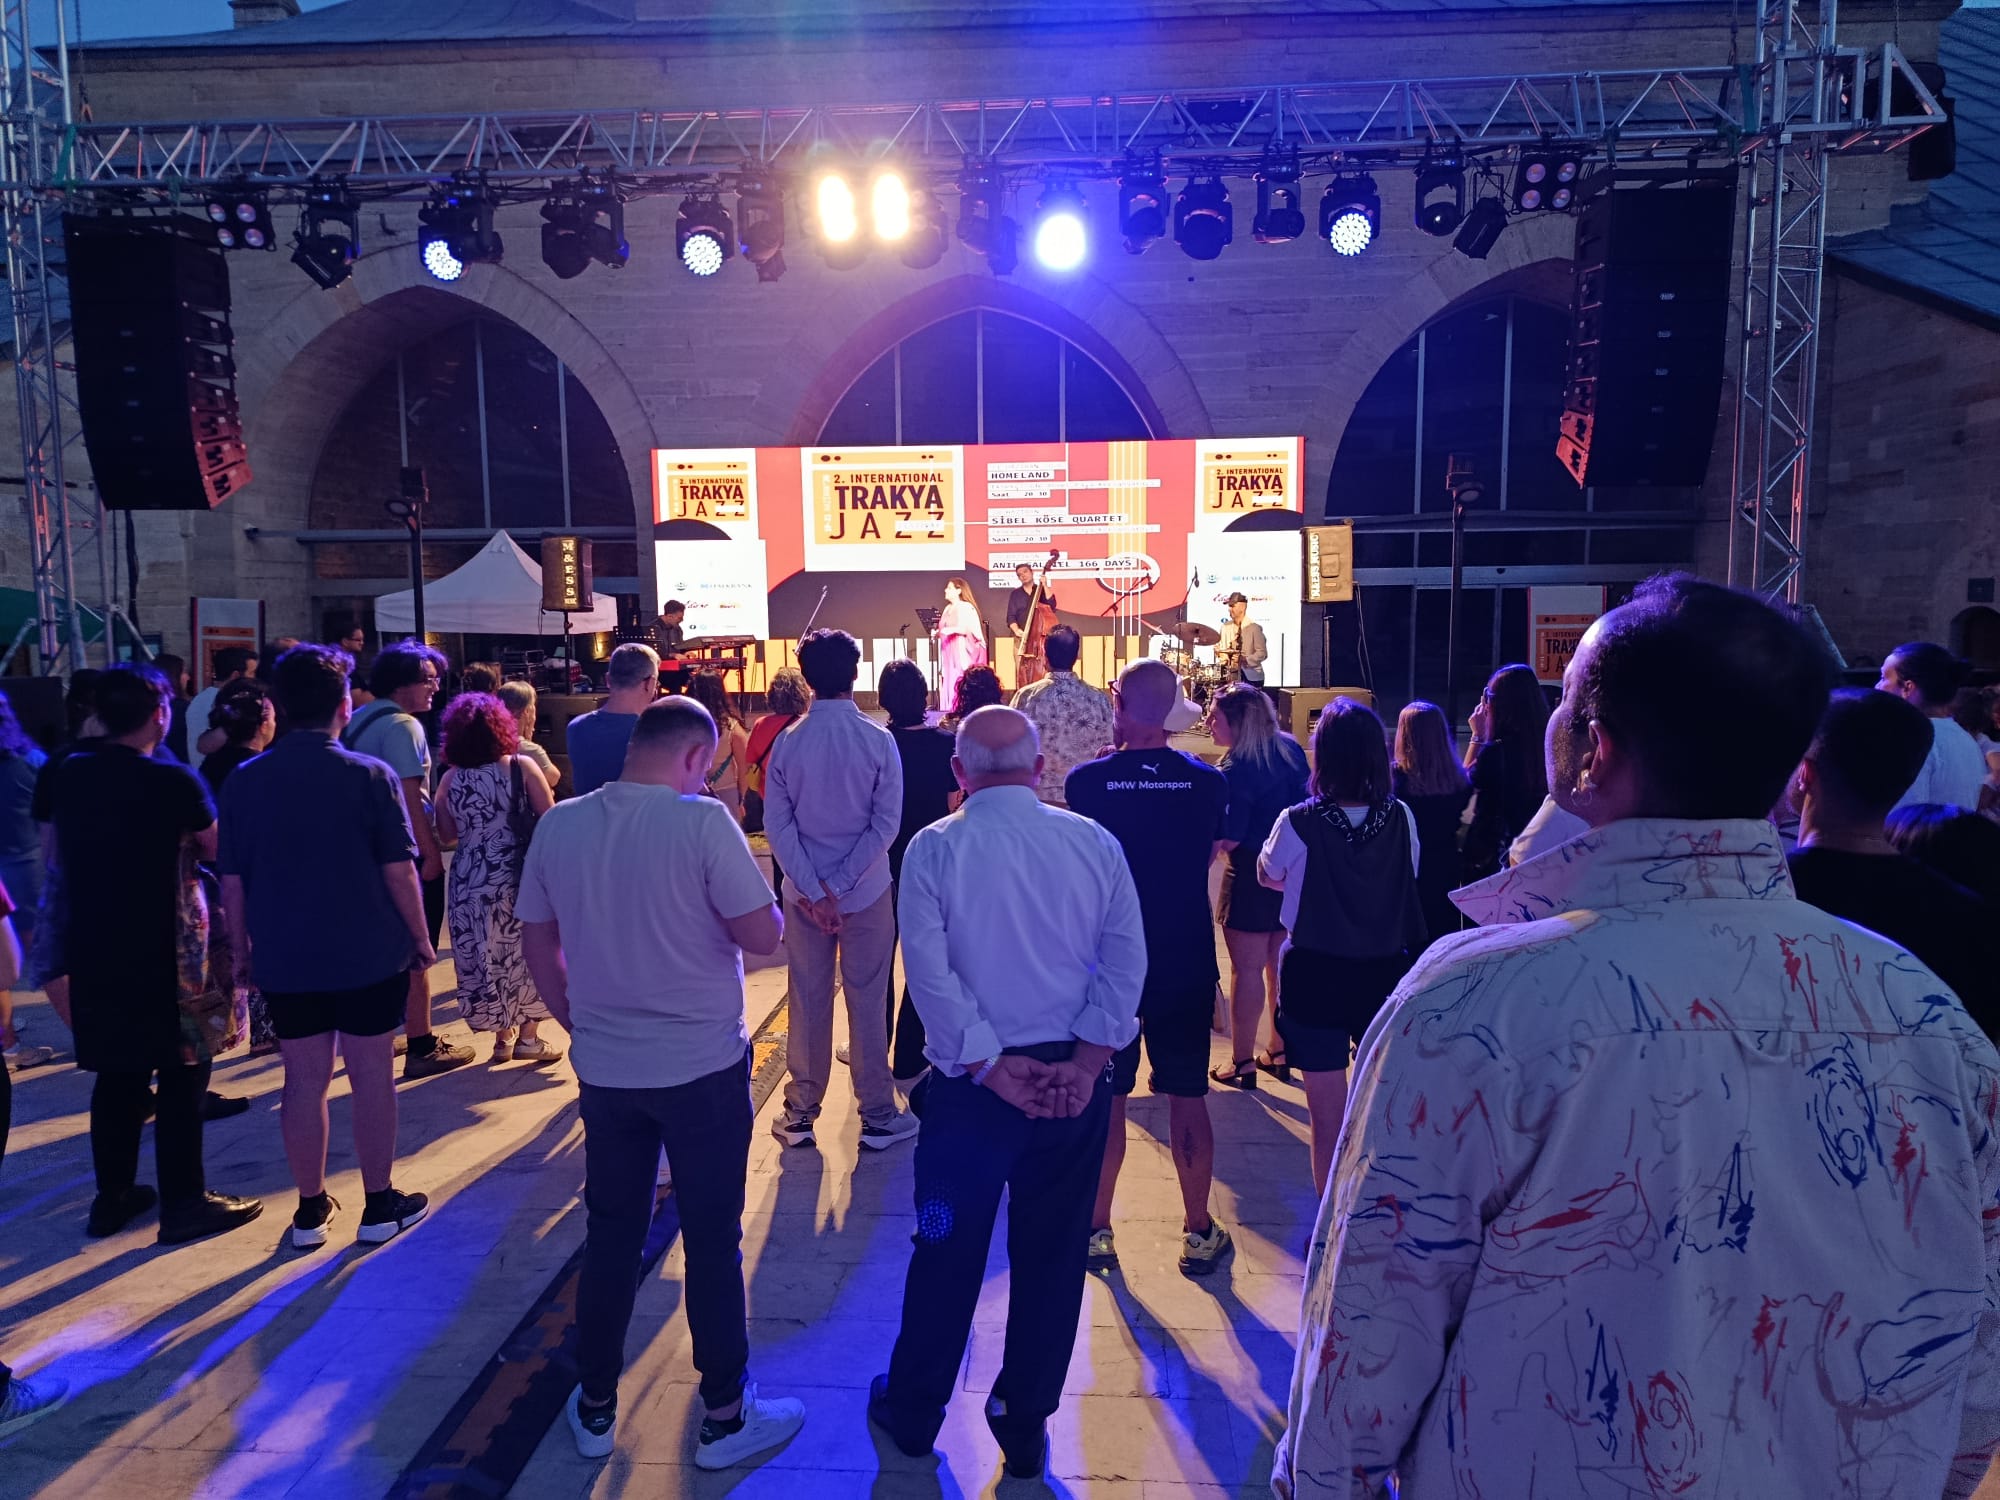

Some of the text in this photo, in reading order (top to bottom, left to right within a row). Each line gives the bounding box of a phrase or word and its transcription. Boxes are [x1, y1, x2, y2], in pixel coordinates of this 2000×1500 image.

[991, 471, 1050, 479] HOMELAND
[1227, 467, 1284, 475] INTERNATIONAL
[834, 473, 944, 484] 2. INTERNATIONAL
[1216, 475, 1283, 490] TRAKYA
[679, 485, 744, 499] TRAKYA
[834, 485, 944, 510] TRAKYA
[991, 514, 1123, 525] SİBEL KÖSE QUARTET
[1079, 560, 1098, 568] 166
[1105, 559, 1132, 567] DAYS
[1106, 780, 1192, 790] BMW Motorsport
